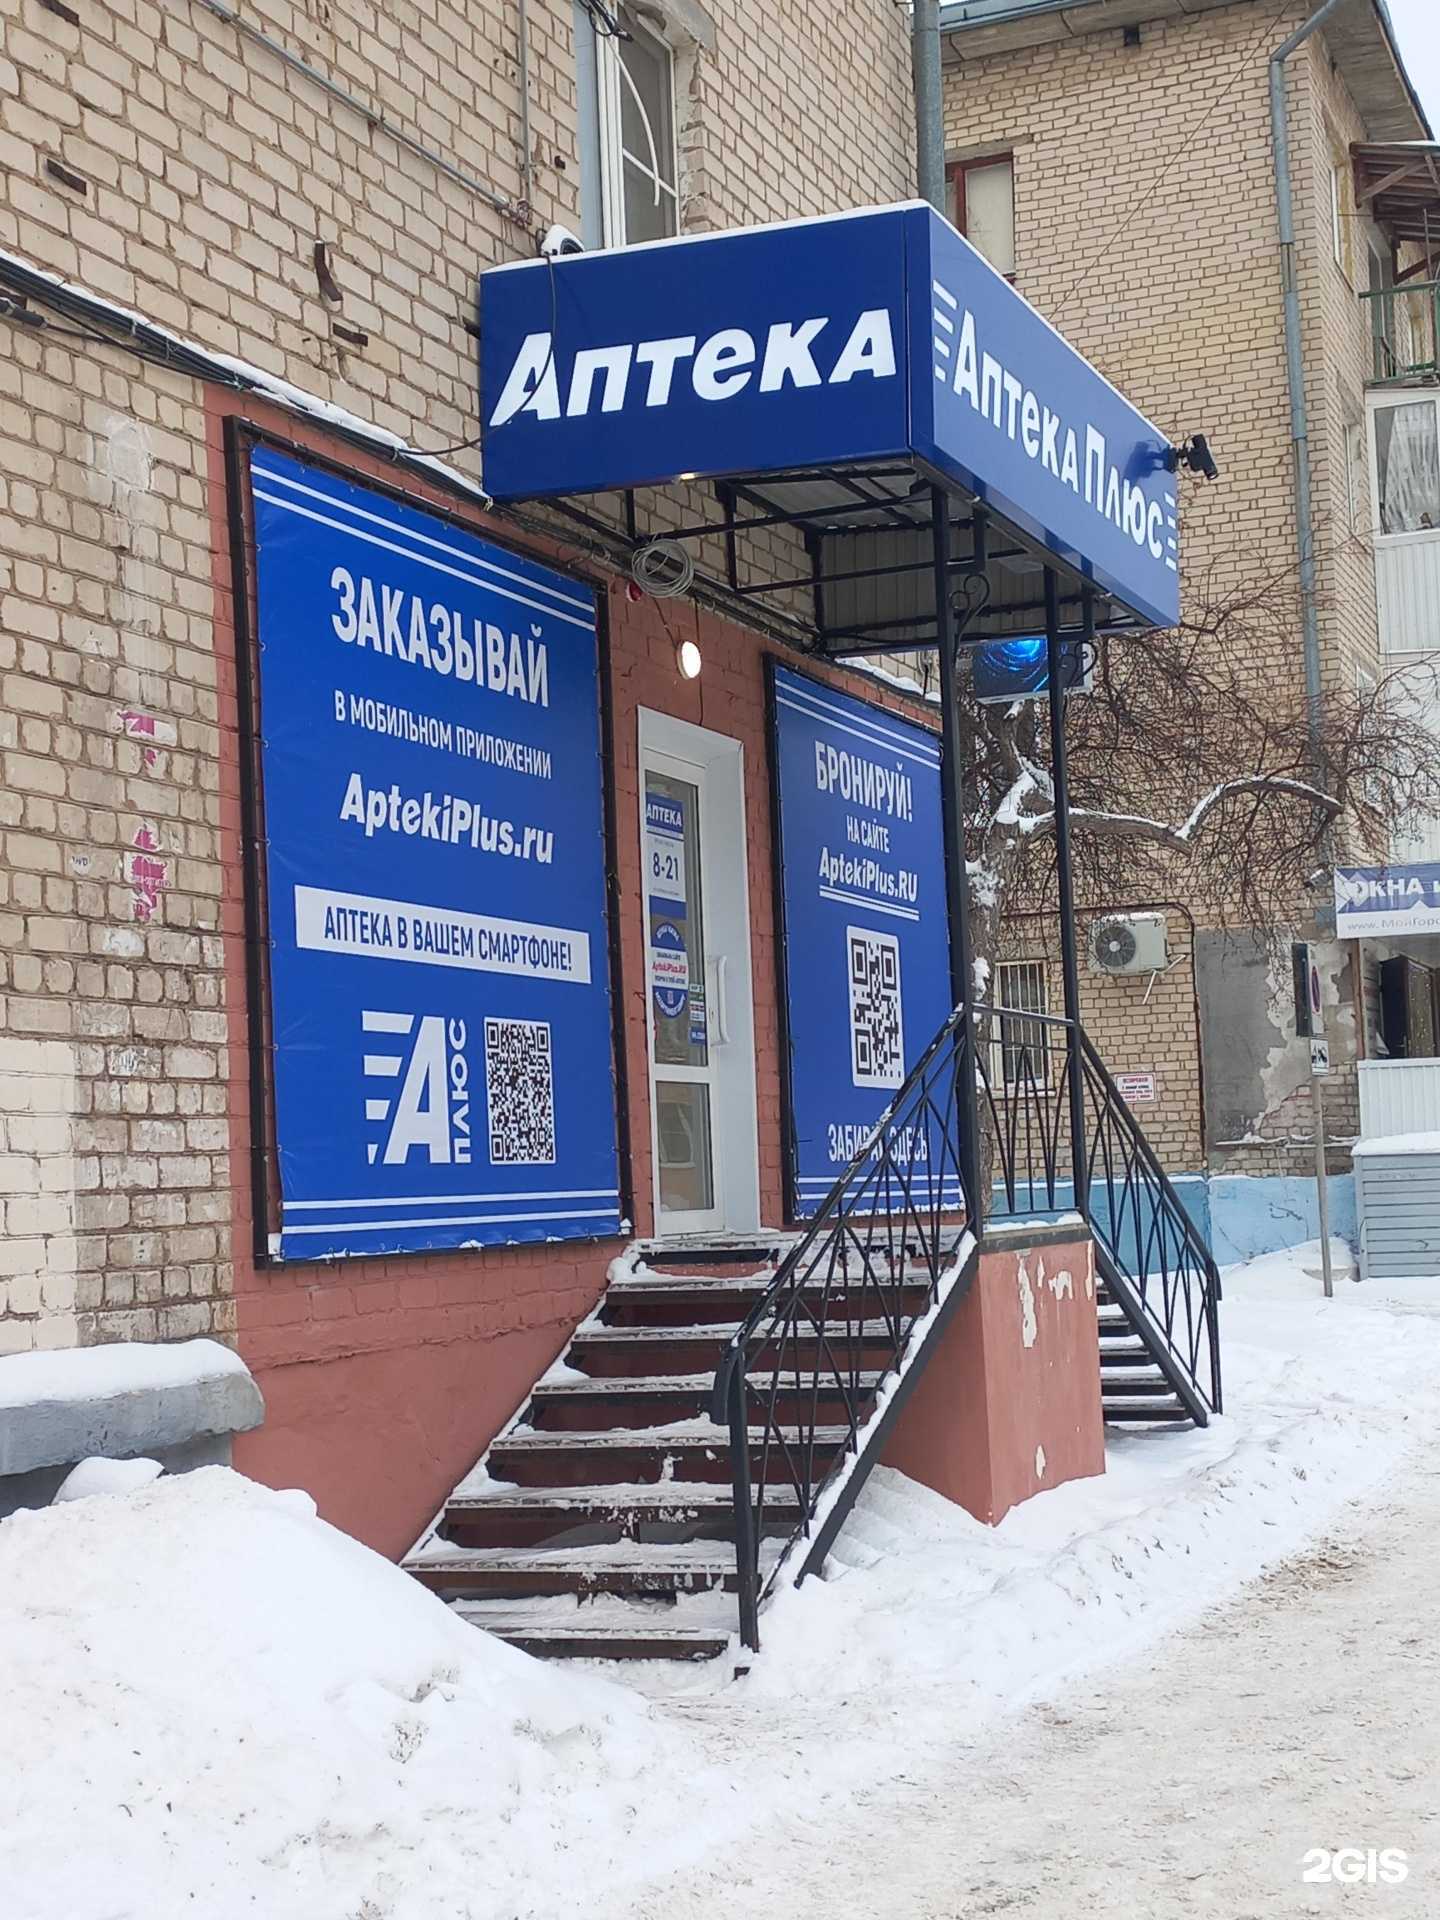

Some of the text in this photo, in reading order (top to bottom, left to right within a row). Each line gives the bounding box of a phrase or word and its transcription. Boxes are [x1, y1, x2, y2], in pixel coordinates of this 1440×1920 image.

[330, 566, 549, 707] ЗАКАЗЫВАЙ
[335, 689, 552, 780] В МОБИЛЬНОМ ПРИЛОЖЕНИИ
[815, 740, 912, 822] БРОНИРУЙ!
[340, 773, 553, 864] AptekiPlus.ru
[647, 803, 682, 827] АПТЕКА
[847, 814, 890, 853] НА САЙТЕ
[653, 851, 679, 882] 8-21
[819, 847, 918, 902] AptekiPlus.RU
[324, 905, 572, 971] АПТЕКА В ВАШЕМ СМАРТФОНЕ!
